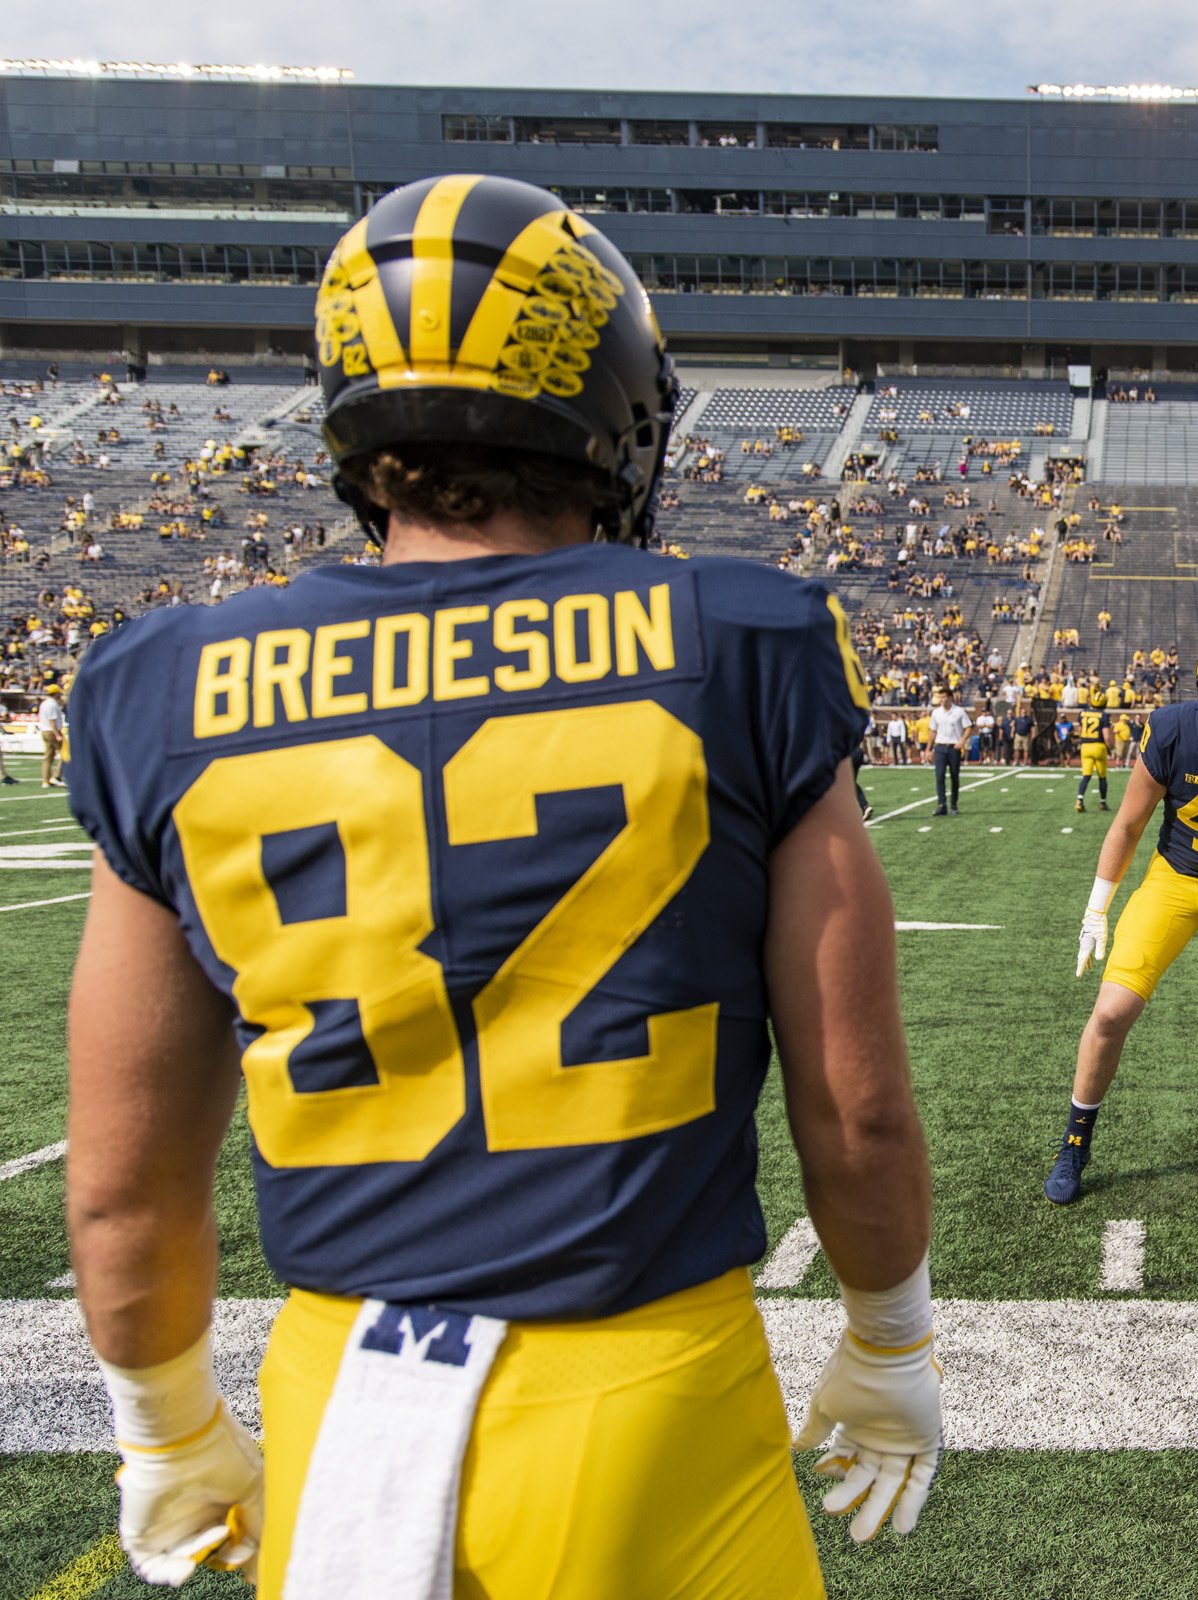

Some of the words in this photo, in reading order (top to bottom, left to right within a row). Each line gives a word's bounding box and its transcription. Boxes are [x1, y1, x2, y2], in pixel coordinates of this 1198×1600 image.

[343, 343, 370, 376] 82
[194, 583, 677, 739] BREDESON
[1081, 716, 1100, 739] 12
[172, 699, 721, 1168] 82
[1068, 1134, 1082, 1147] M
[360, 1303, 474, 1368] M
